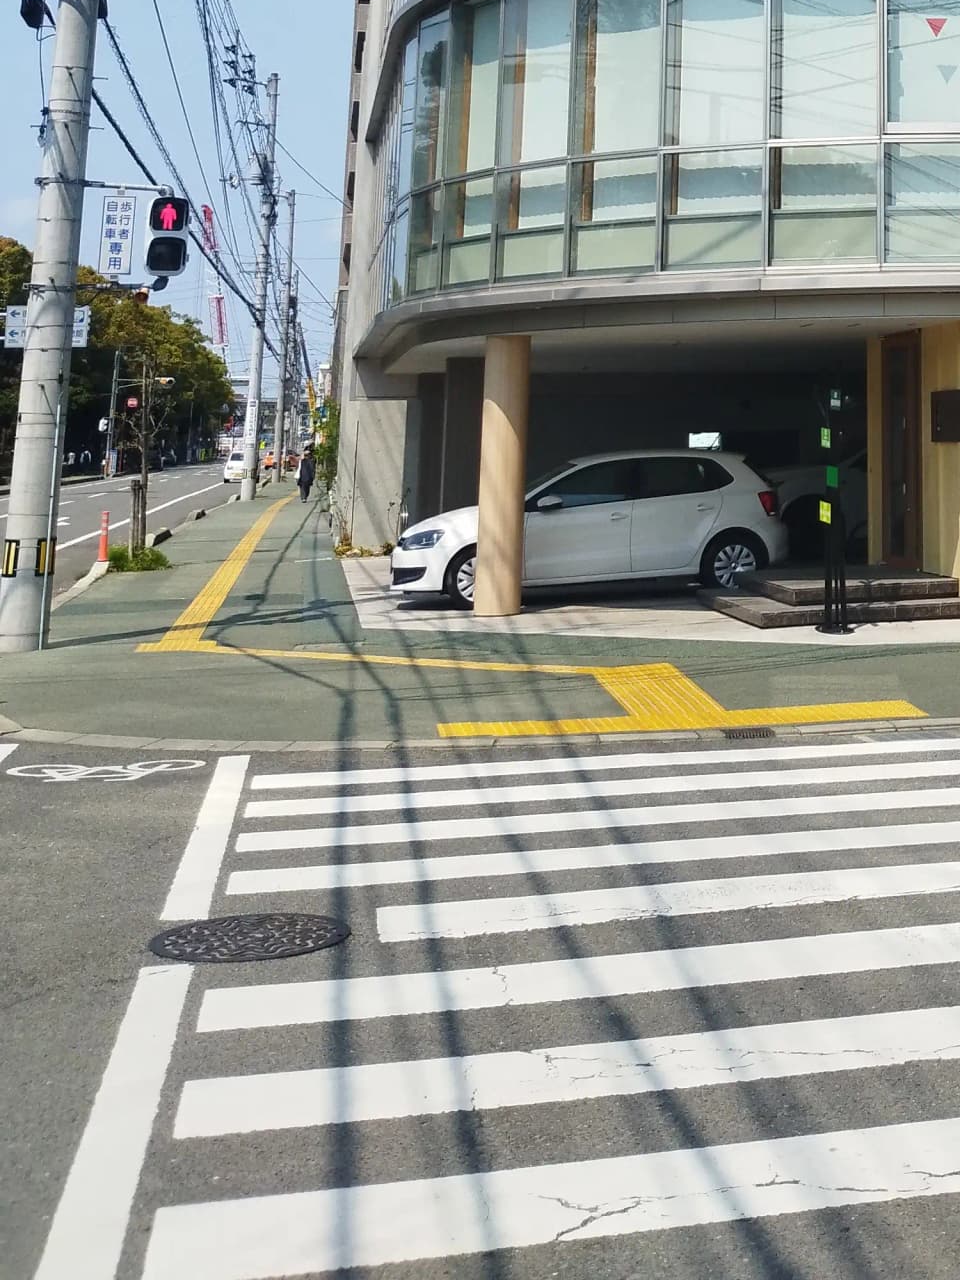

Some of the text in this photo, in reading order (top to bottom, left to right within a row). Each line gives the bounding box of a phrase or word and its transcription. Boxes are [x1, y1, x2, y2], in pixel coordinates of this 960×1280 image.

[104, 201, 118, 239] 自転車
[118, 201, 132, 239] 歩行者
[108, 242, 123, 270] 専用
